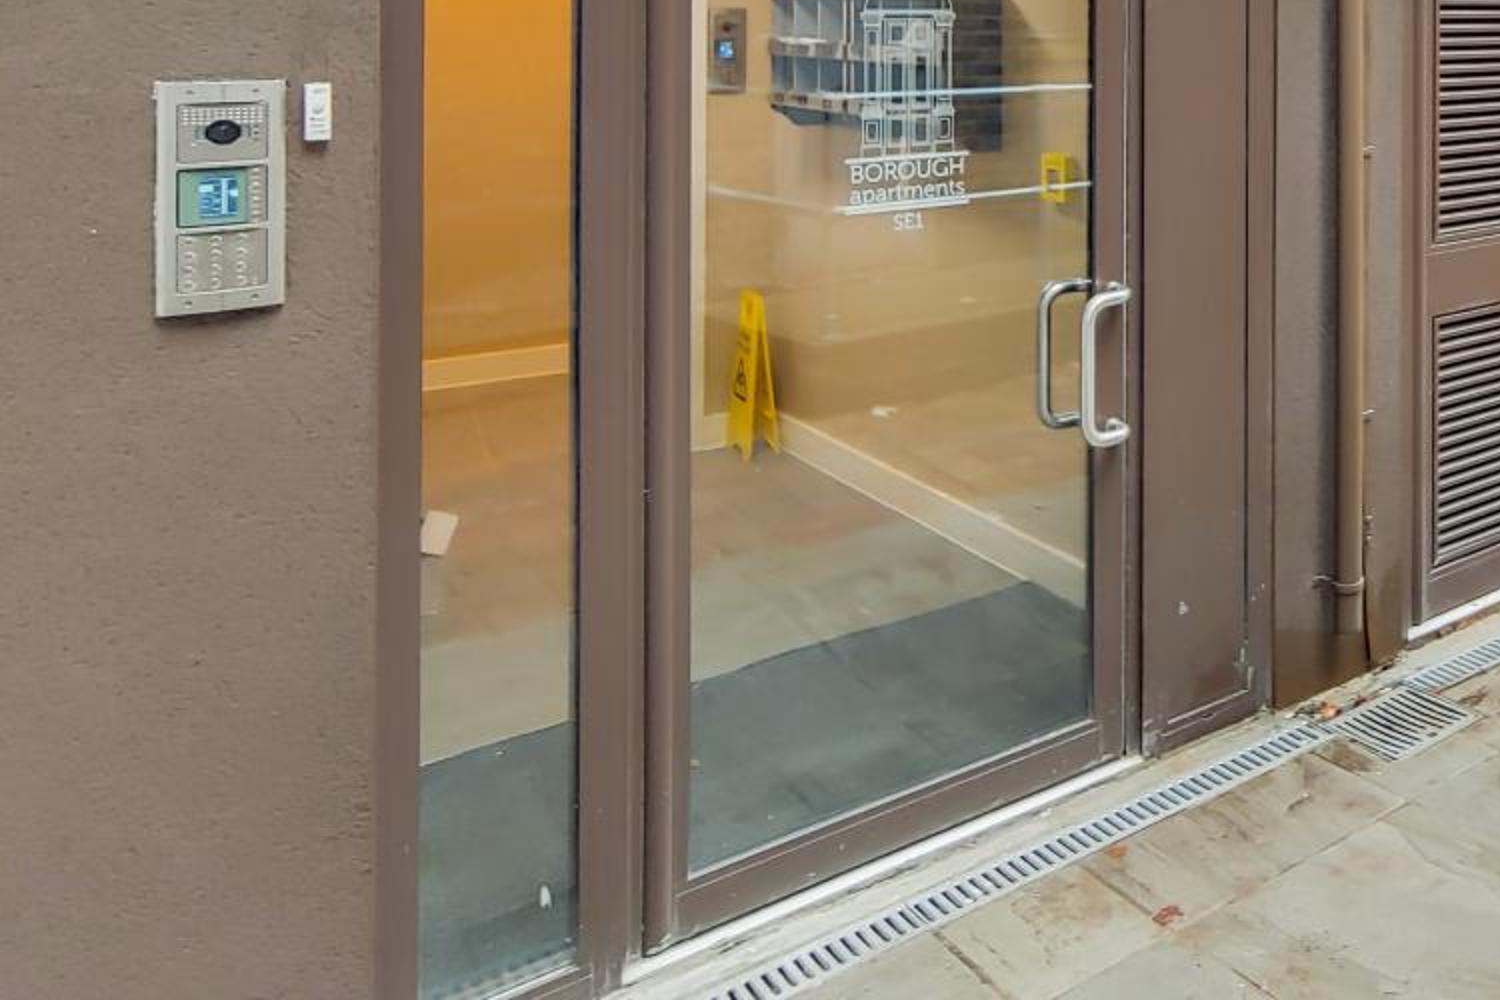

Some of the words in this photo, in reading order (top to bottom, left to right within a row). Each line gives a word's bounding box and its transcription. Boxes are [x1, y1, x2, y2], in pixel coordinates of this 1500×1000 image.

[850, 156, 965, 185] BOROUGH
[849, 179, 966, 206] apartments
[893, 211, 924, 231] SE1
